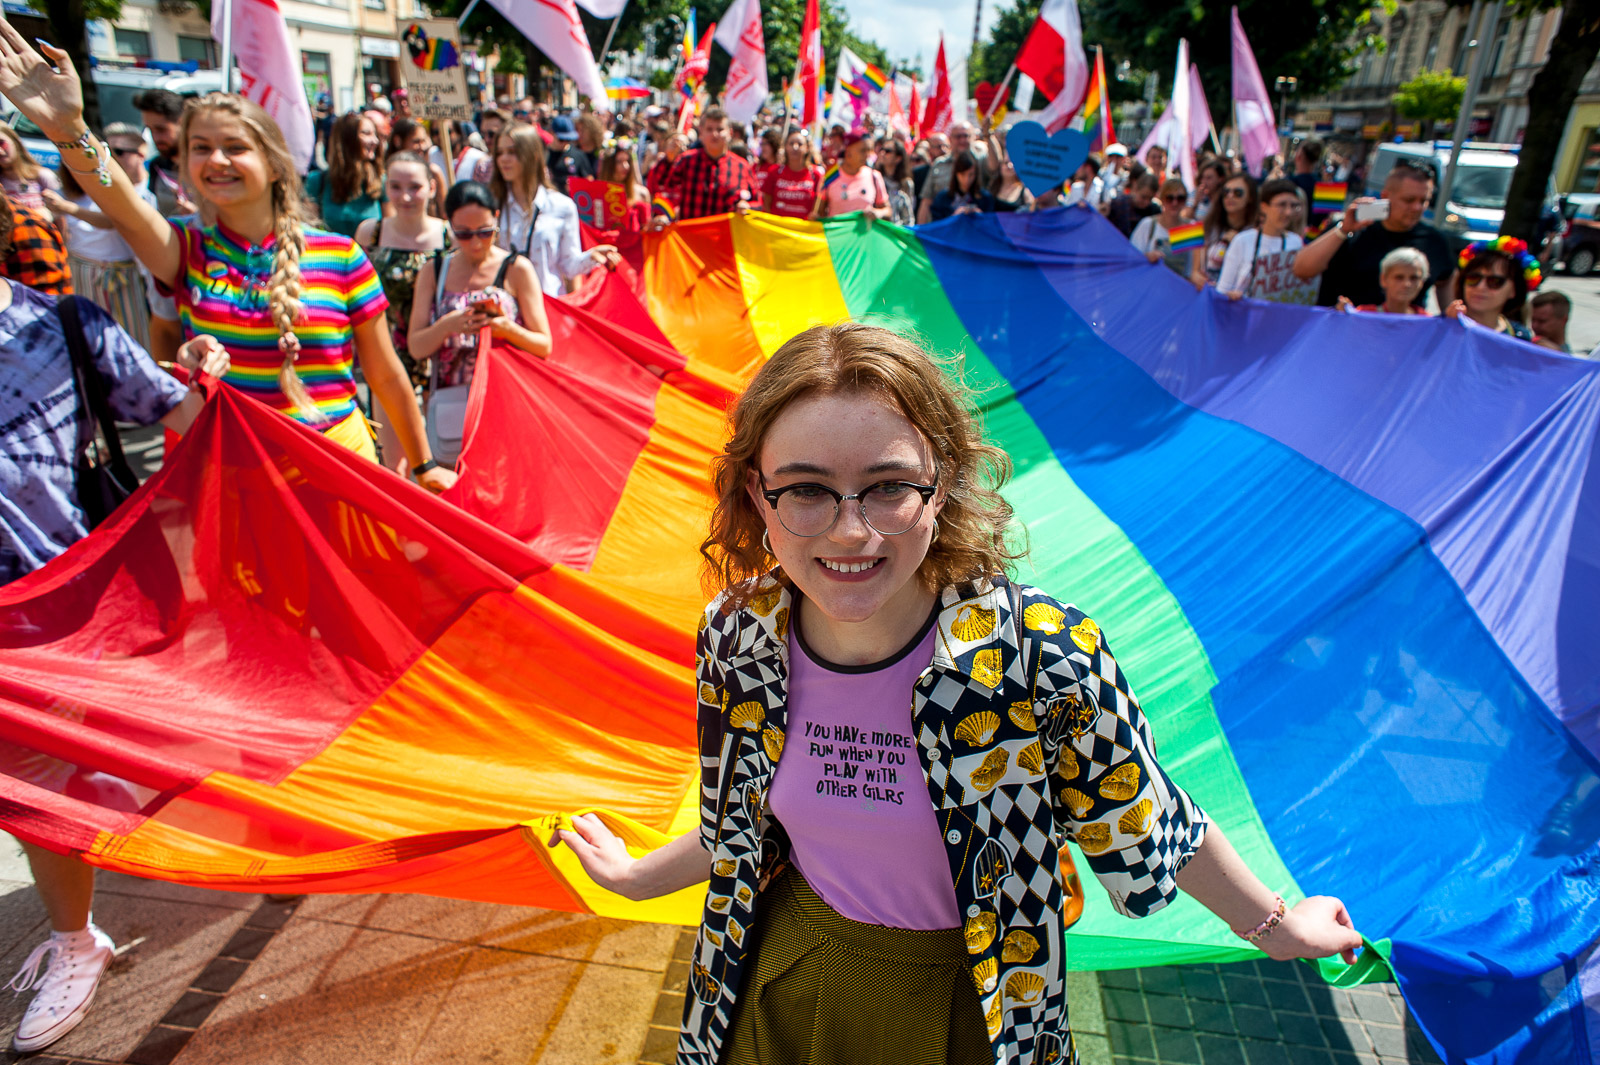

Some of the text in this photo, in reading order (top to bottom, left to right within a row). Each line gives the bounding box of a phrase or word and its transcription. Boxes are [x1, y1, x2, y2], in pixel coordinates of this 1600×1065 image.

[805, 721, 830, 739] YOU
[834, 725, 867, 744] HAVE
[810, 742, 905, 765] FUN WHEN YOU
[824, 762, 859, 779] PLAY
[816, 780, 857, 798] OTHER
